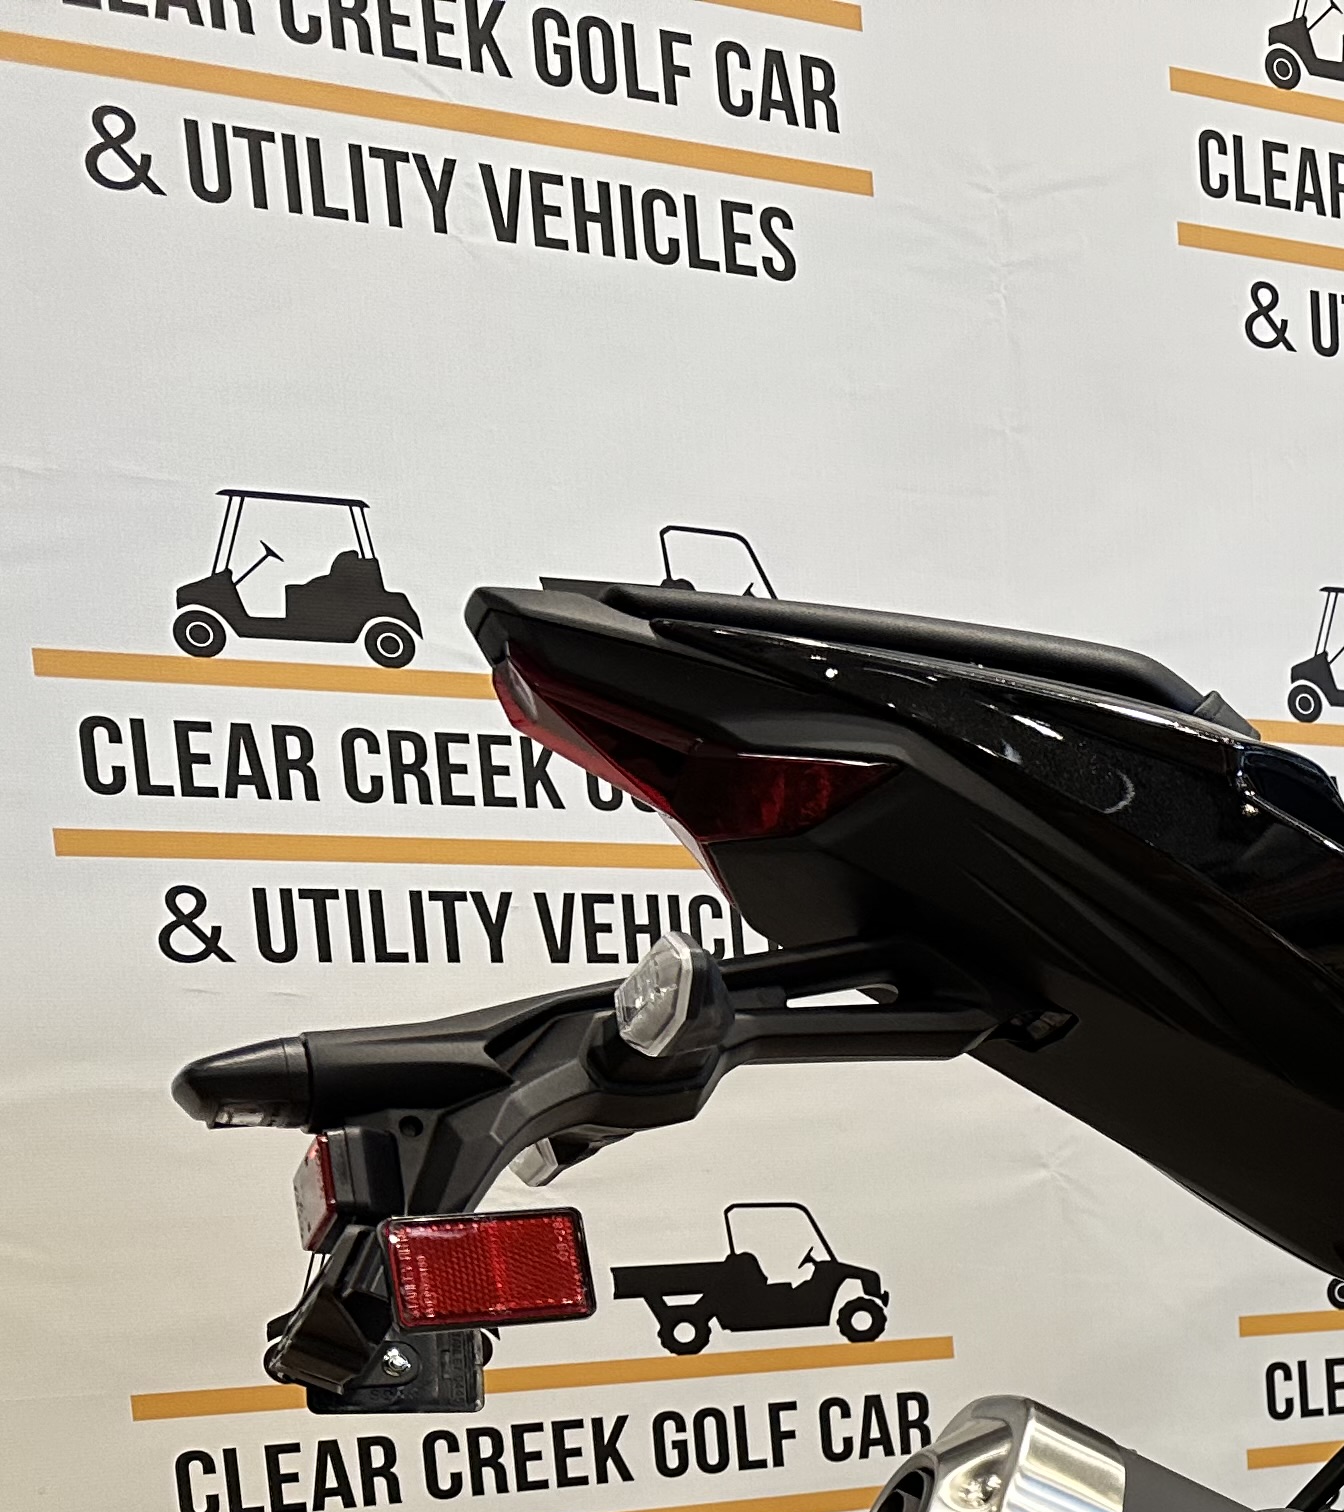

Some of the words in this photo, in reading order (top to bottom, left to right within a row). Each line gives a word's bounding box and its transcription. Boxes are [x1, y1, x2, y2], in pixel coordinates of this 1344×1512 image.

[532, 8, 692, 106] GOLF
[716, 41, 840, 133] CAR
[85, 106, 167, 196] &
[184, 118, 456, 234] UTILITY
[479, 163, 796, 281] VEHICLES
[1245, 281, 1297, 352] &
[79, 716, 320, 801] CLEAR
[341, 728, 565, 809] CREEK
[159, 885, 236, 963] &
[252, 888, 512, 963] UTILITY
[533, 892, 776, 963] VEHICL
[423, 1415, 634, 1499] CREEK
[653, 1401, 797, 1478] GOLF
[819, 1392, 931, 1461] CAR
